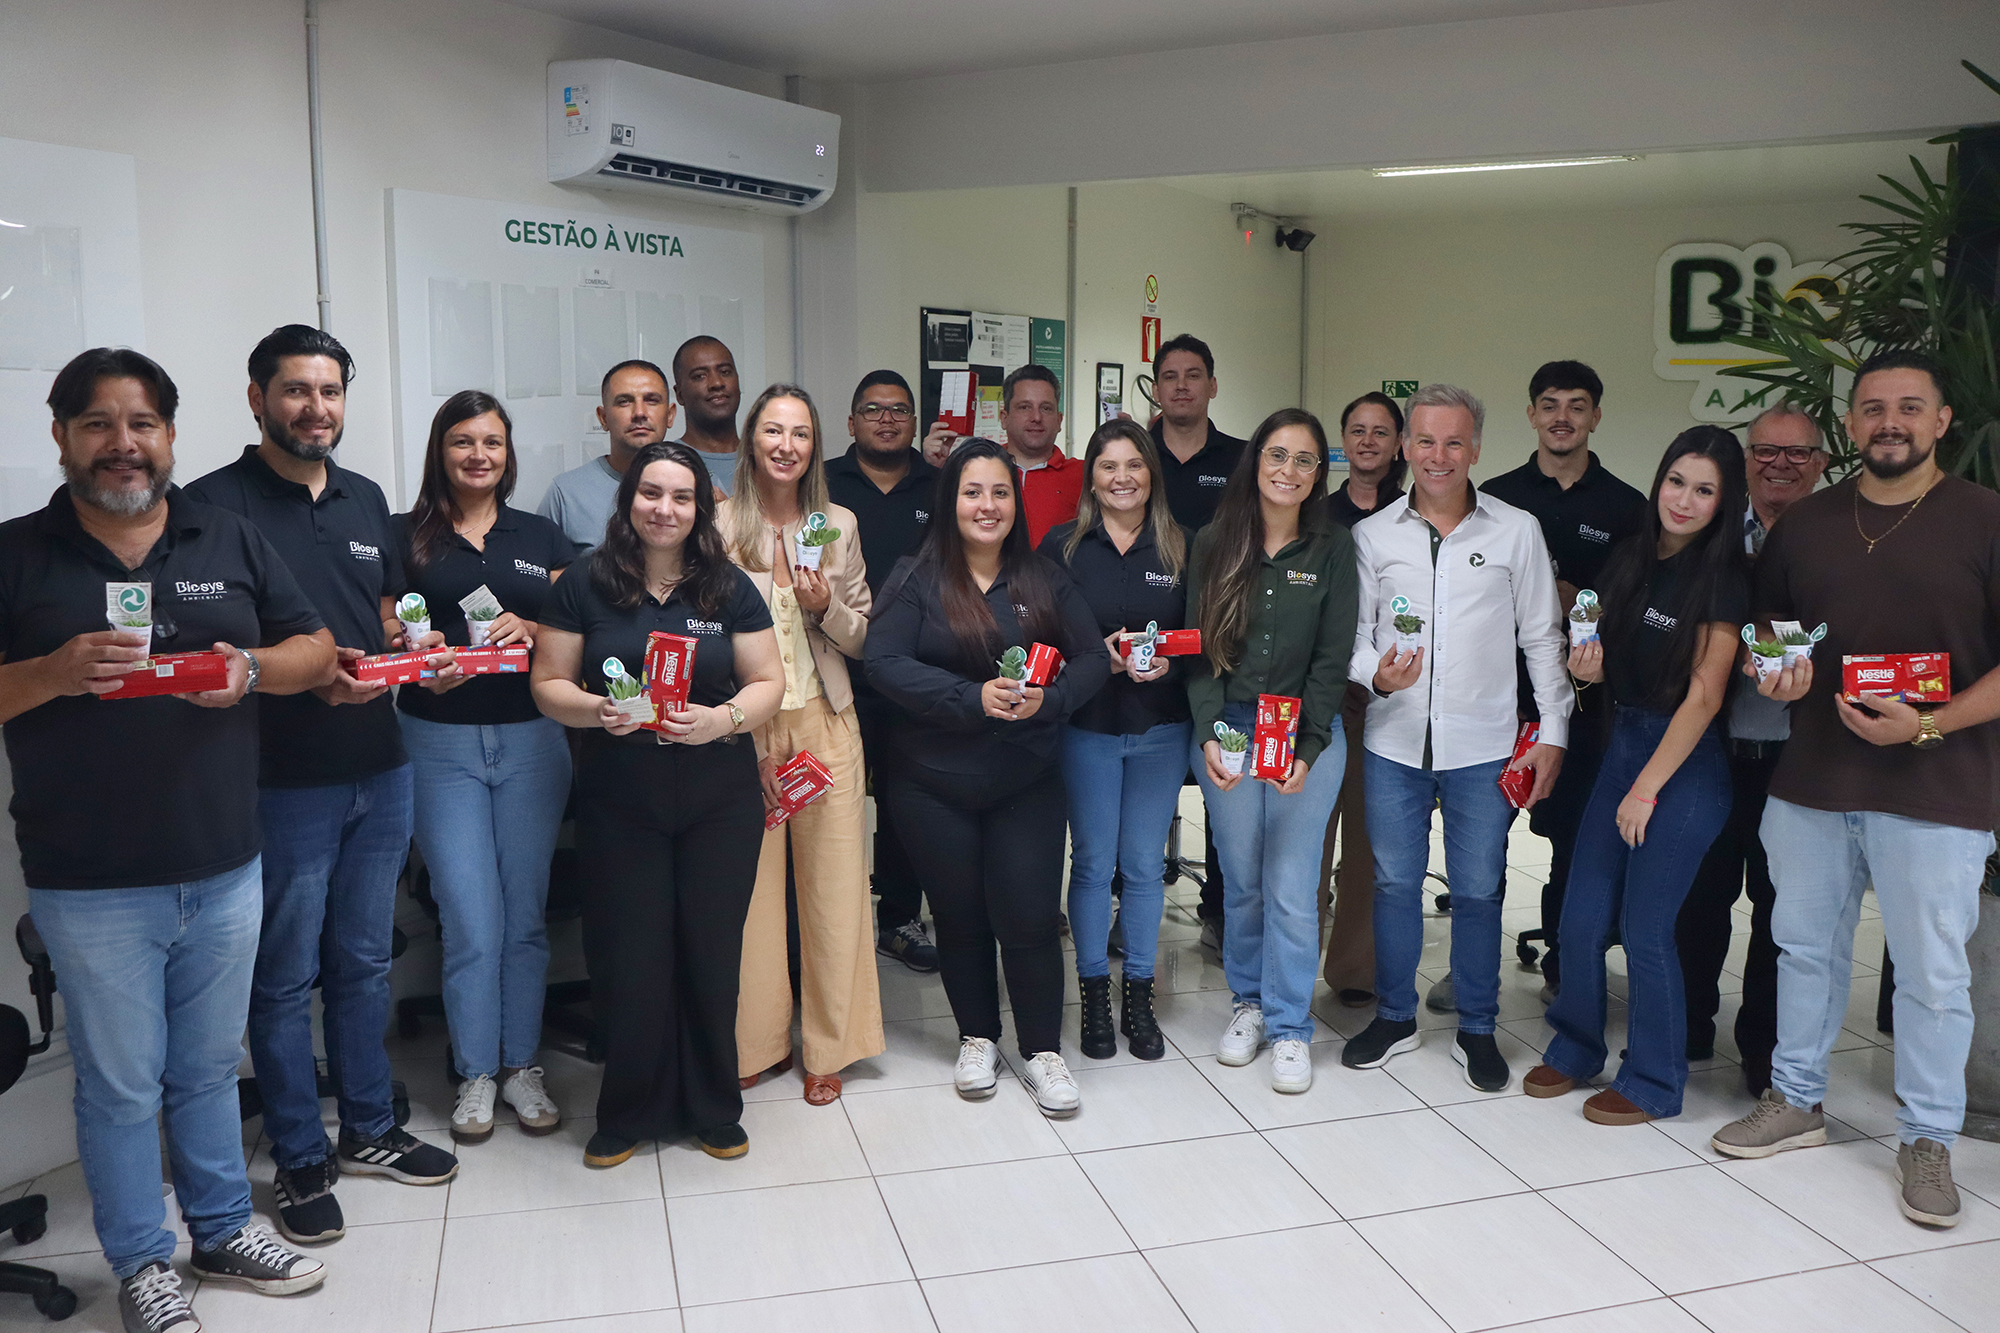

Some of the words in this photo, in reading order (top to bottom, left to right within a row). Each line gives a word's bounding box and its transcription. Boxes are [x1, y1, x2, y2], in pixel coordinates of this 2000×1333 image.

[816, 144, 825, 157] 22
[505, 219, 598, 249] GESTÃO
[604, 223, 621, 251] À
[624, 231, 684, 258] VISTA
[1199, 474, 1227, 483] Biosys
[915, 509, 930, 519] Bio
[1579, 523, 1610, 540] Biosys
[349, 541, 379, 556] Biosys
[514, 559, 547, 574] Biosys
[1287, 569, 1317, 581] Biosys
[175, 580, 224, 594] Biosys
[1012, 603, 1029, 612] Bio
[1645, 607, 1678, 627] Biosys
[686, 619, 723, 631] Biosys
[664, 651, 680, 686] Nestlé
[1857, 668, 1895, 680] Nestlé
[1262, 737, 1275, 767] Nestlé
